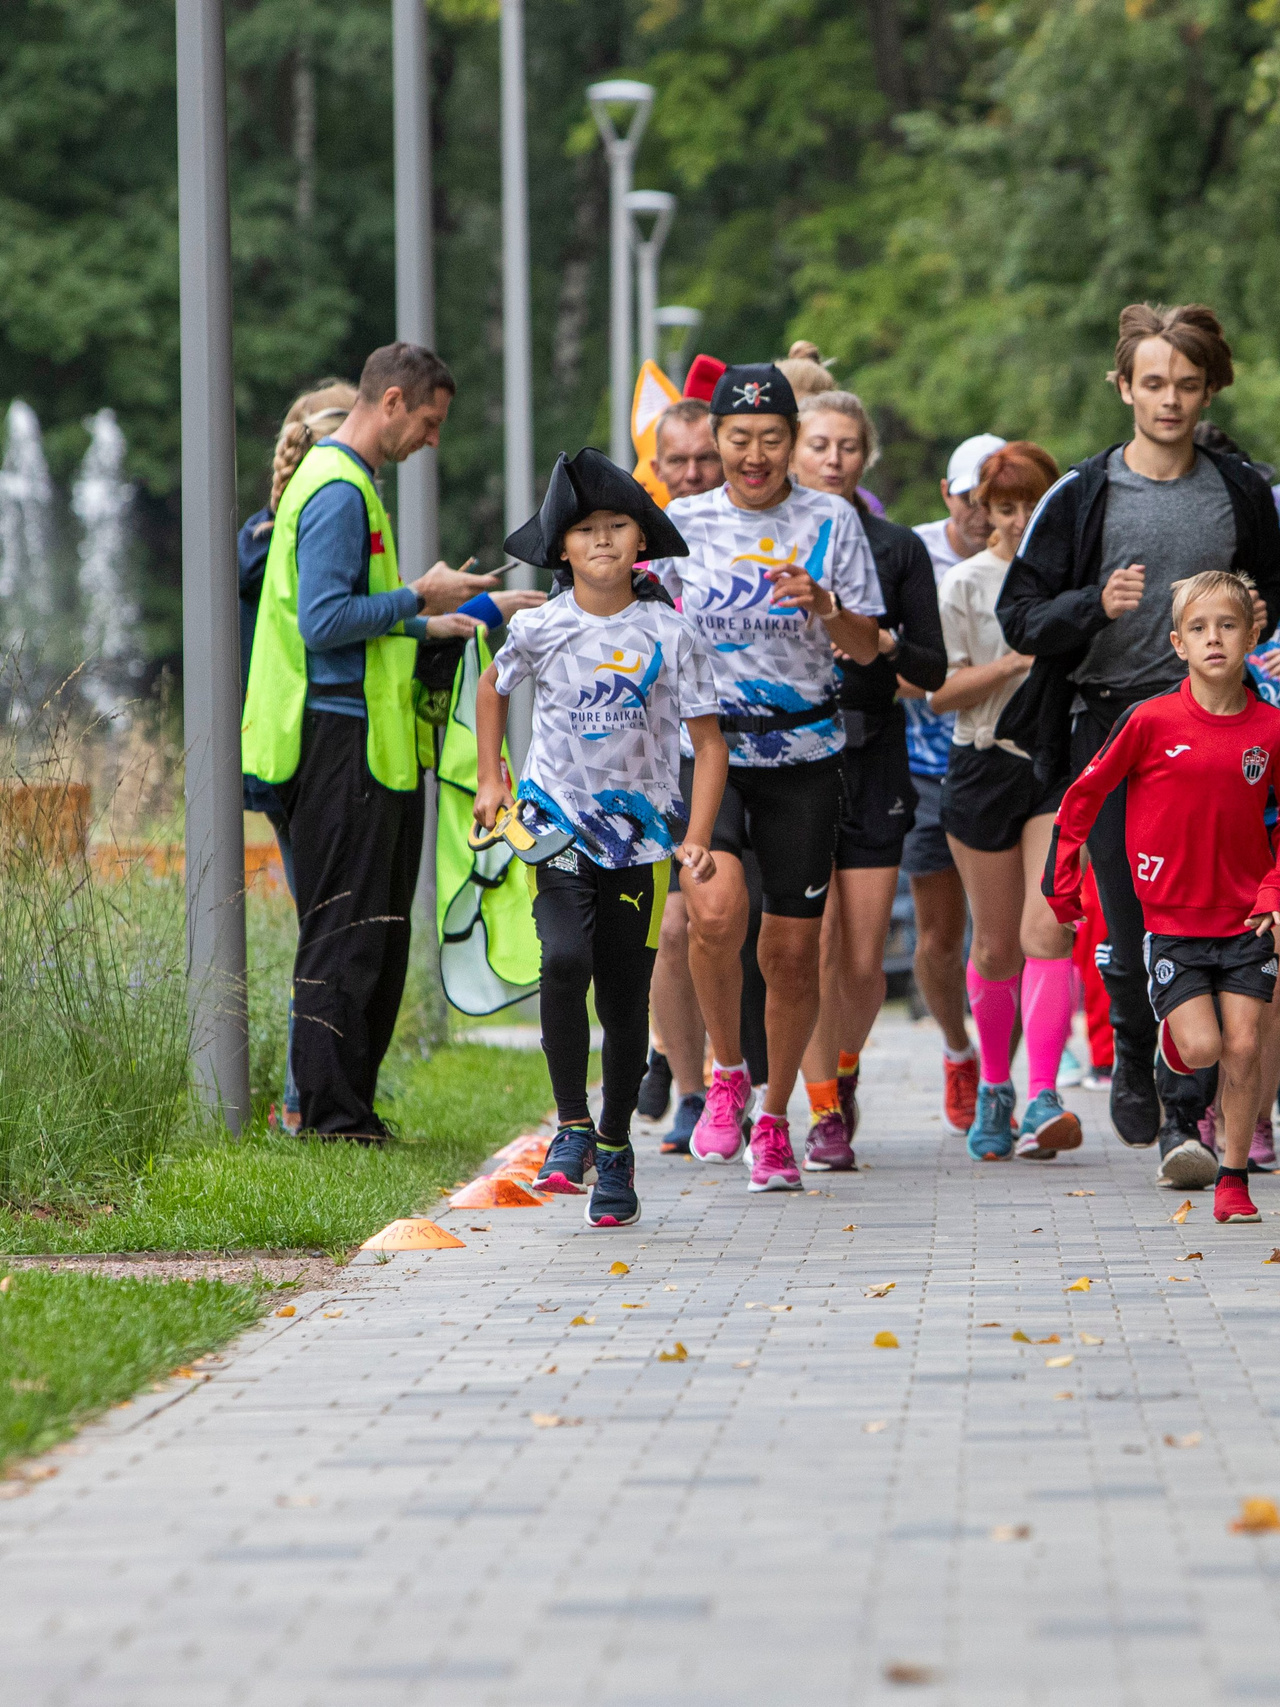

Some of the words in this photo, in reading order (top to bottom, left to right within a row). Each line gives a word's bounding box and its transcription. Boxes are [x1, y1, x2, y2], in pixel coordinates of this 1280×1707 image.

[696, 615, 737, 630] PURE
[743, 618, 799, 632] BAIKAL
[700, 630, 800, 640] MARATHON
[571, 712, 600, 722] PURE
[605, 710, 644, 721] BAIKAL
[572, 721, 644, 731] MARATHON
[1137, 852, 1165, 882] 27
